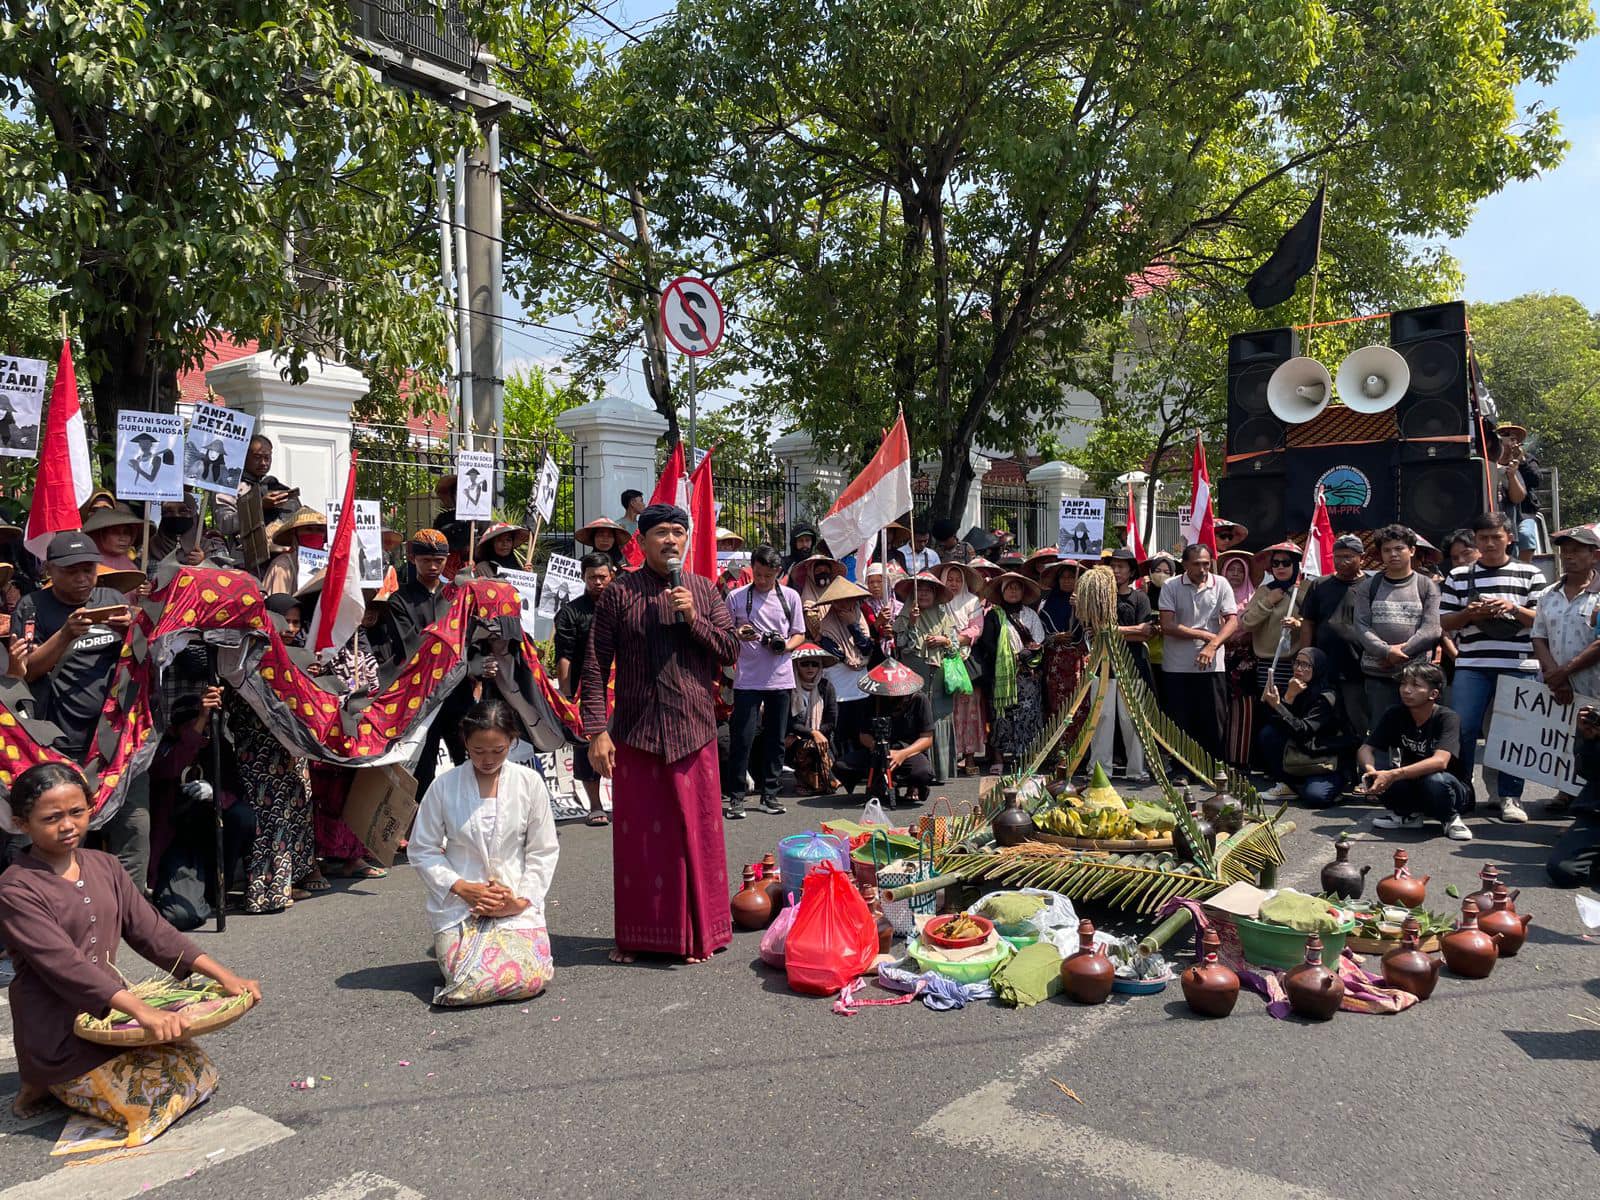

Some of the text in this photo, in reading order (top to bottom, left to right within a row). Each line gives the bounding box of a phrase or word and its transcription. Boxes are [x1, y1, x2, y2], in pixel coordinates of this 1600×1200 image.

[196, 403, 235, 422] TANPA
[121, 415, 182, 427] PETANI SOKO
[197, 414, 247, 437] PETANI
[118, 423, 184, 436] GURU BANGSA
[327, 503, 363, 513] TAA
[1061, 500, 1091, 508] TANPA
[1064, 507, 1101, 516] PETANI
[333, 513, 376, 525] PANI
[551, 556, 577, 569] TANPA
[551, 564, 582, 579] PETAN
[73, 634, 115, 650] NDRED
[1514, 686, 1576, 726] KAMI
